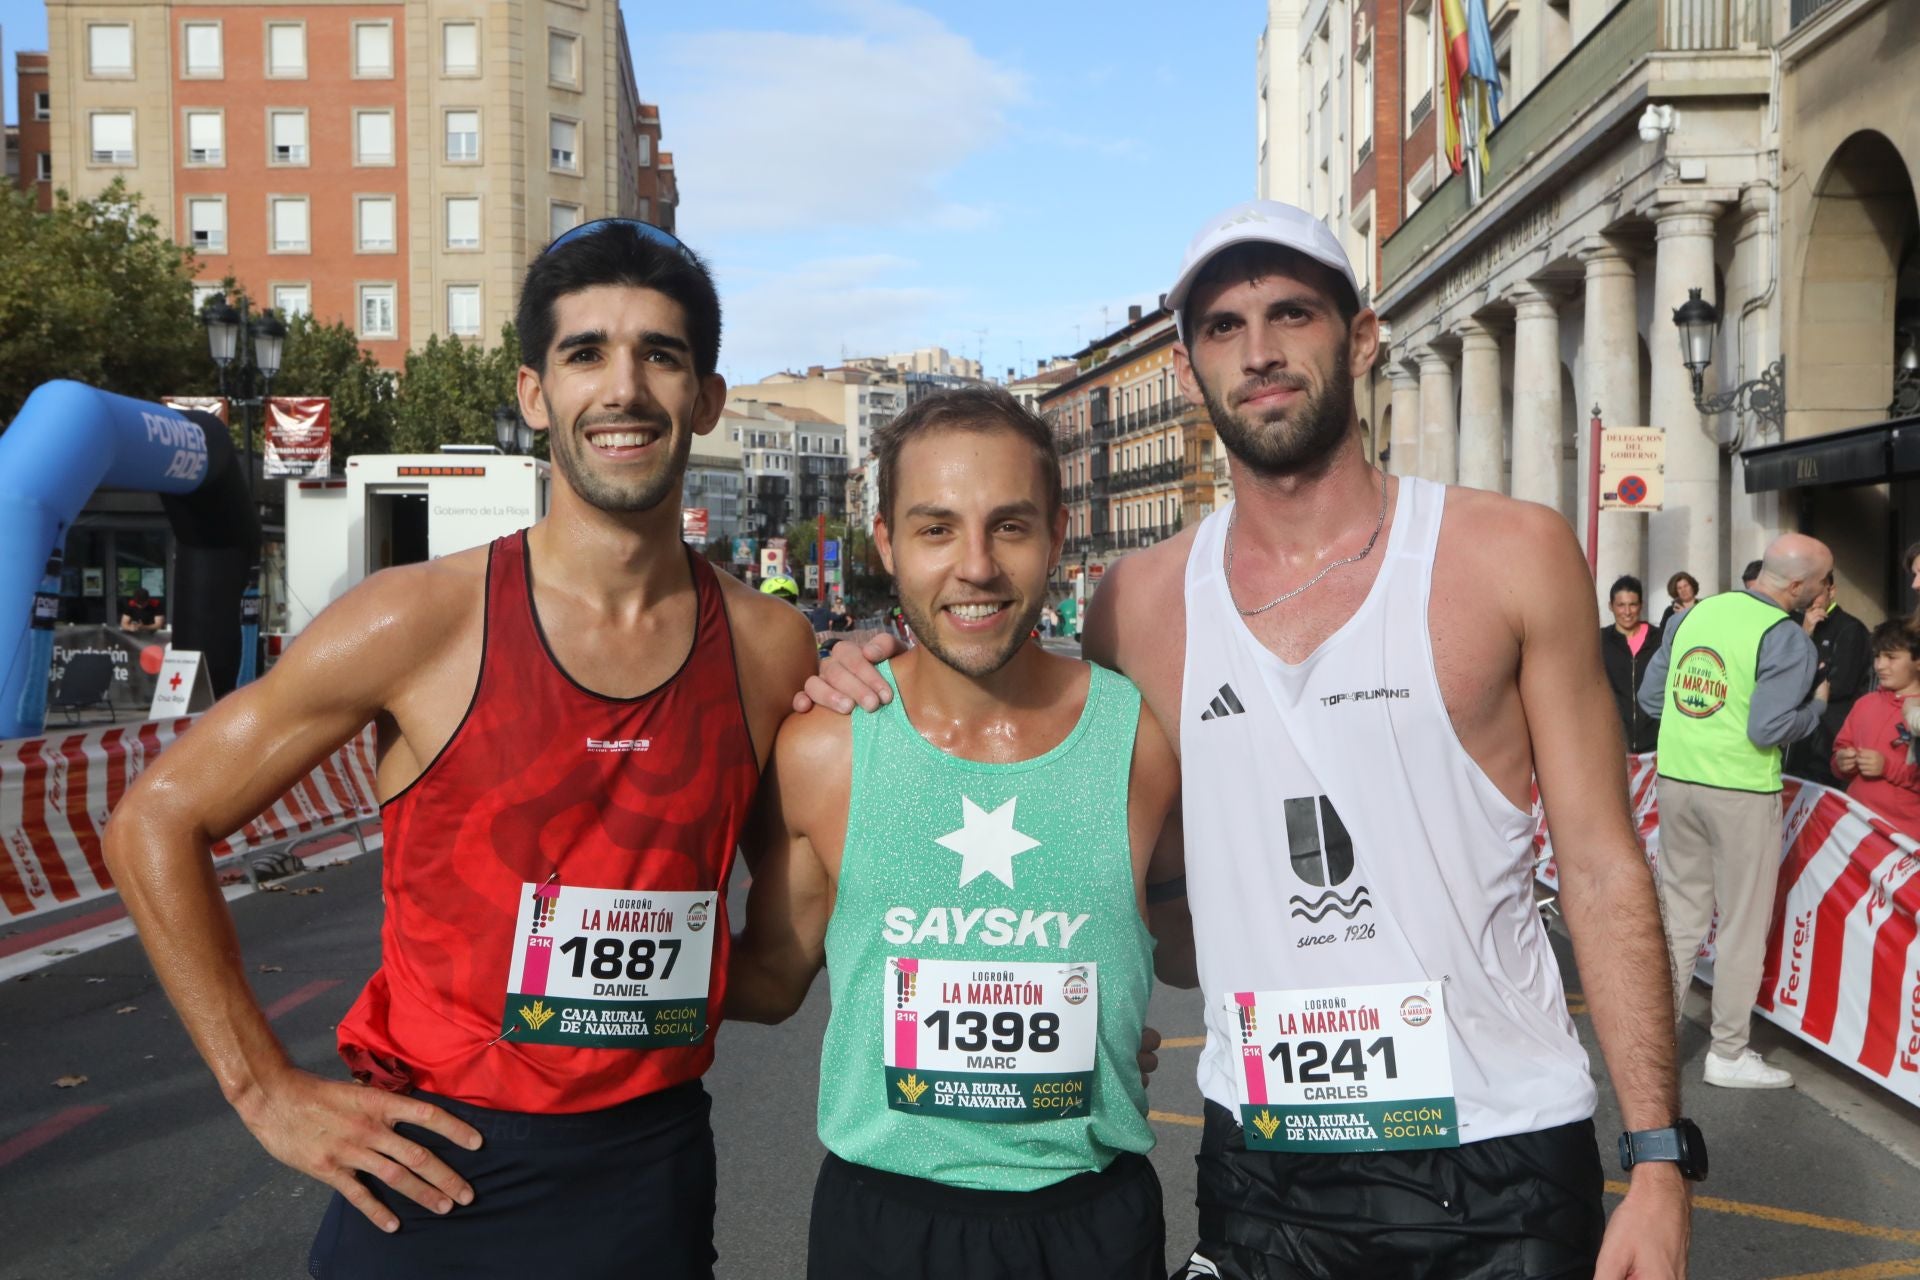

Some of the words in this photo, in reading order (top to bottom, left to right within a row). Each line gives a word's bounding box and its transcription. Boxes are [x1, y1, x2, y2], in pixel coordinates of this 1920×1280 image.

[141, 412, 207, 453] POWER
[1607, 434, 1662, 442] DELEGACION
[165, 450, 207, 480] ADE
[434, 506, 478, 516] Gobierno
[480, 506, 491, 516] de
[493, 507, 504, 516] La
[506, 506, 529, 517] Rioja
[1673, 672, 1681, 688] LA
[1682, 674, 1728, 700] MARATÓN
[614, 898, 652, 910] LOGROÑO
[582, 909, 600, 930] LA
[607, 908, 673, 933] MARATÓN
[882, 906, 1091, 949] SAYSKY
[529, 938, 551, 947] 21K
[1297, 932, 1337, 948] since
[1344, 923, 1376, 943] 1926
[559, 936, 682, 980] 1887
[1780, 916, 1805, 1007] Ferrer
[973, 971, 1014, 982] LOGROÑO
[593, 983, 649, 997] DANIEL
[943, 983, 961, 1004] LA
[967, 981, 1043, 1005] MARATÓN
[1305, 998, 1346, 1010] LOGROÑO
[562, 1008, 598, 1021] CAJA
[601, 1009, 645, 1022] RURAL
[656, 1007, 697, 1020] ACCIÓN
[897, 1013, 916, 1022] 21K
[1278, 1013, 1297, 1035] LA
[1303, 1006, 1380, 1034] MARATÓN
[559, 1021, 581, 1033] DE
[584, 1022, 649, 1035] NAVARRA
[654, 1022, 693, 1035] SOCIAL
[923, 1010, 1060, 1053] 1398
[1244, 1047, 1261, 1057] 21K
[966, 1056, 1017, 1069] MARC
[1268, 1036, 1397, 1084] 1241
[935, 1081, 966, 1094] CAJA
[972, 1083, 1020, 1096] RURAL
[1033, 1080, 1082, 1093] ACCIÓN
[1304, 1085, 1368, 1100] CARLES
[934, 1094, 955, 1106] DE
[958, 1096, 1026, 1108] NAVARRA
[1285, 1115, 1318, 1128] CAJA
[1319, 1114, 1369, 1126] RURAL
[1383, 1107, 1442, 1123] ACCIÓN
[1287, 1128, 1304, 1141] DE
[1308, 1126, 1378, 1141] NAVARRA
[1384, 1125, 1442, 1139] SOCIAL
